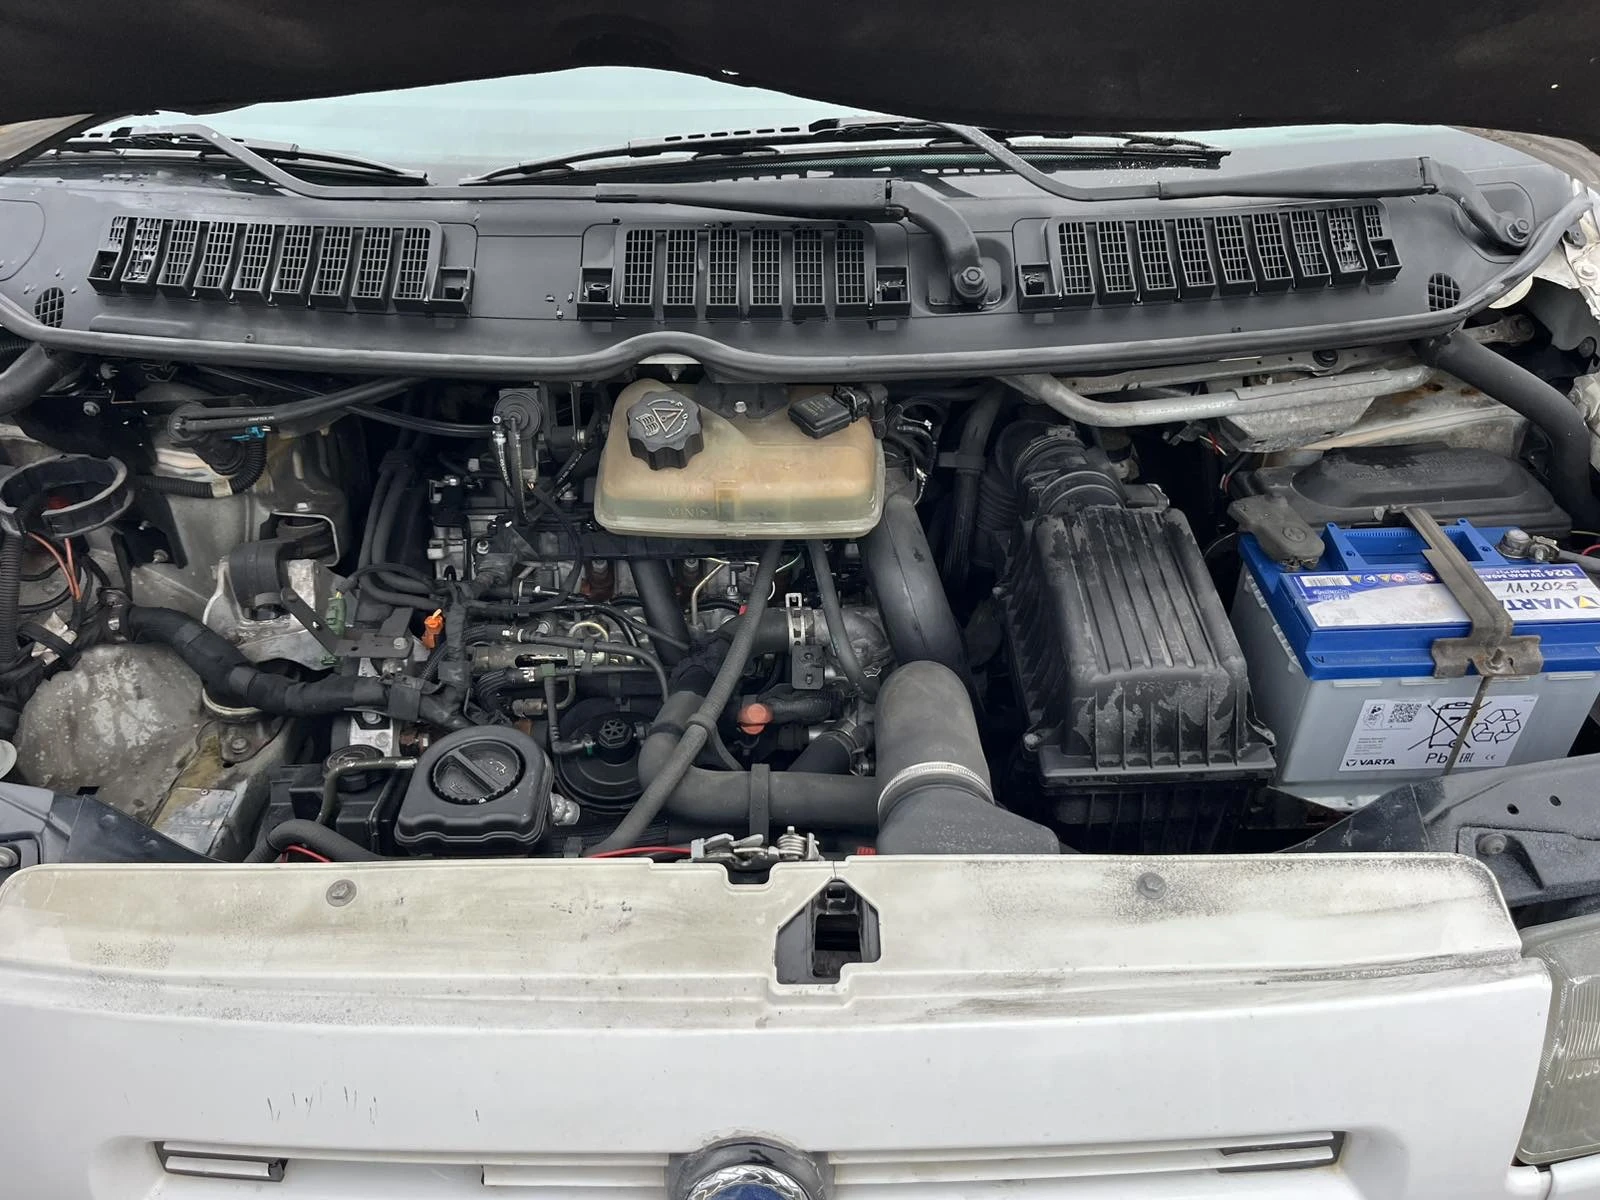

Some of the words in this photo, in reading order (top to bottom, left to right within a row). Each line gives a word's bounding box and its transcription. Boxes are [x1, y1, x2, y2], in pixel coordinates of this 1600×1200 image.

[1501, 597, 1574, 610] VART
[1360, 758, 1395, 766] VARTA
[1425, 753, 1448, 764] Pb
